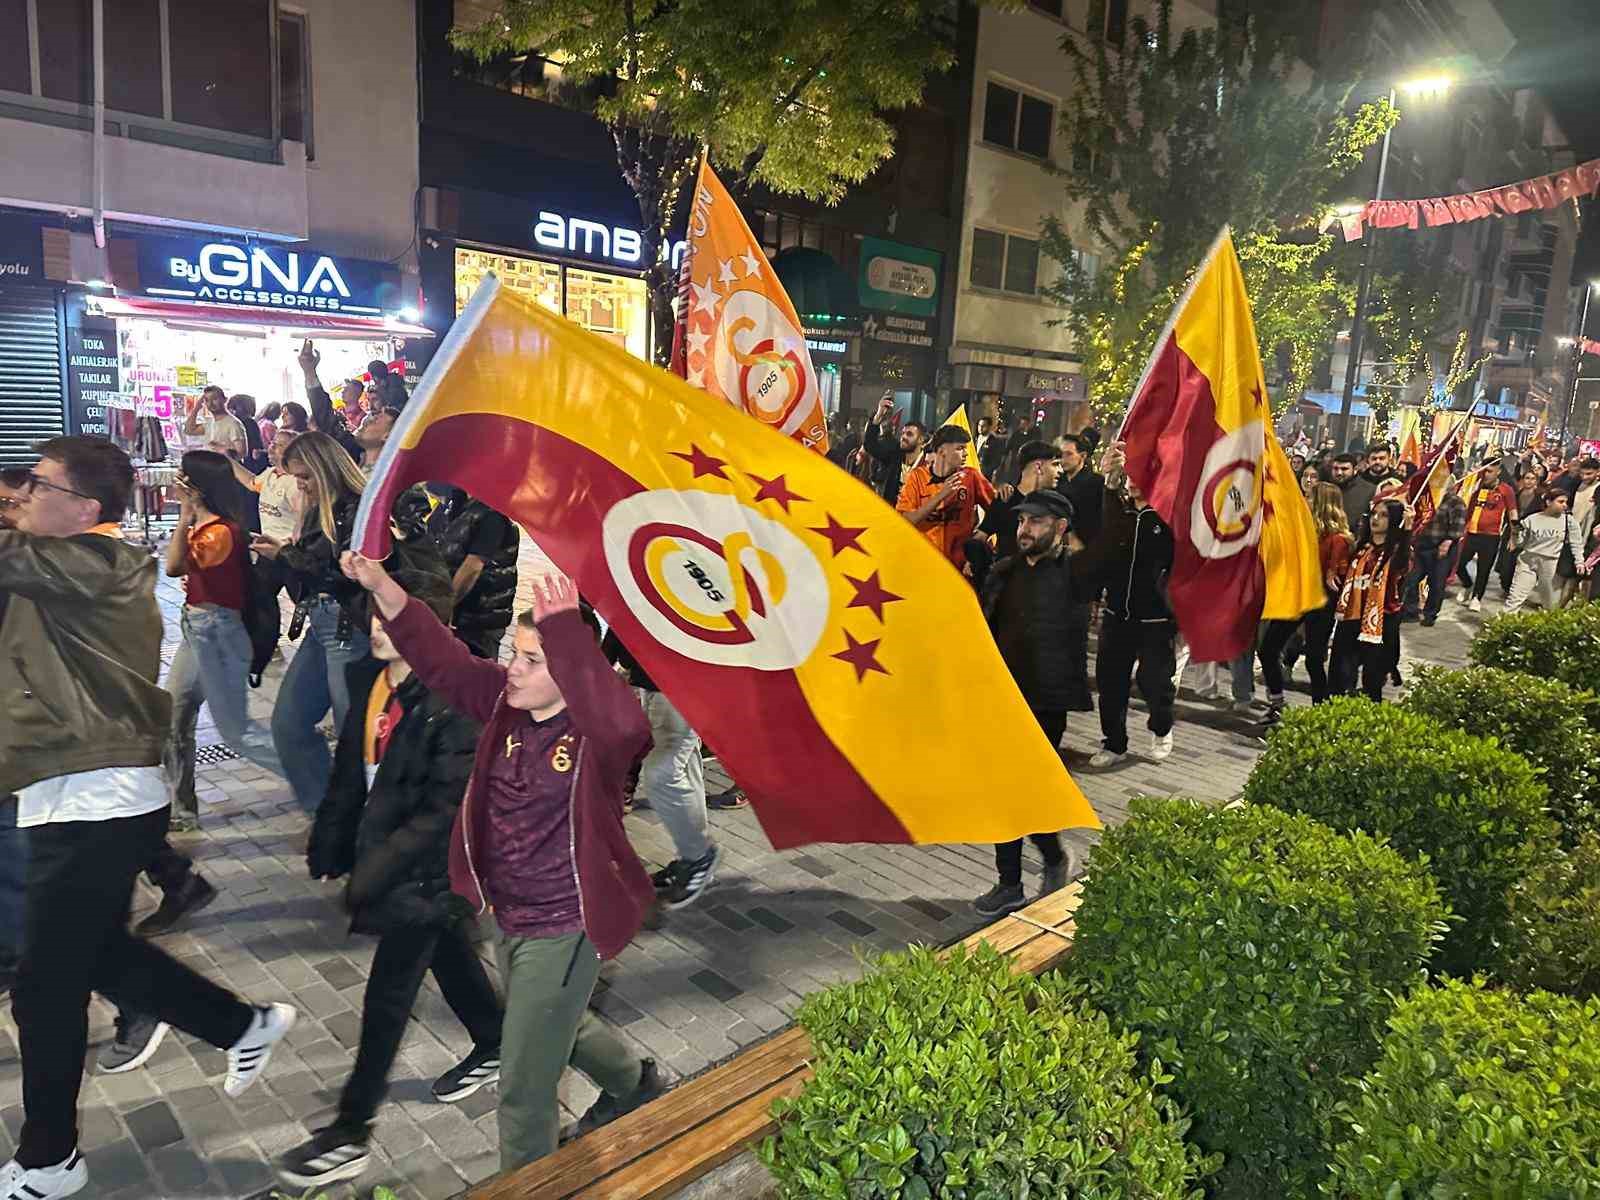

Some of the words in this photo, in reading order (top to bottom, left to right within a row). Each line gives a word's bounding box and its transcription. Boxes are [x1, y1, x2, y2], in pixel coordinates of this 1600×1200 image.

[170, 258, 200, 283] By
[200, 243, 351, 298] GNA
[198, 286, 341, 309] ACCESSORIES
[82, 339, 105, 350] TOKA
[79, 372, 112, 384] TAKILAR
[757, 370, 778, 397] 1905
[683, 560, 725, 602] 1905
